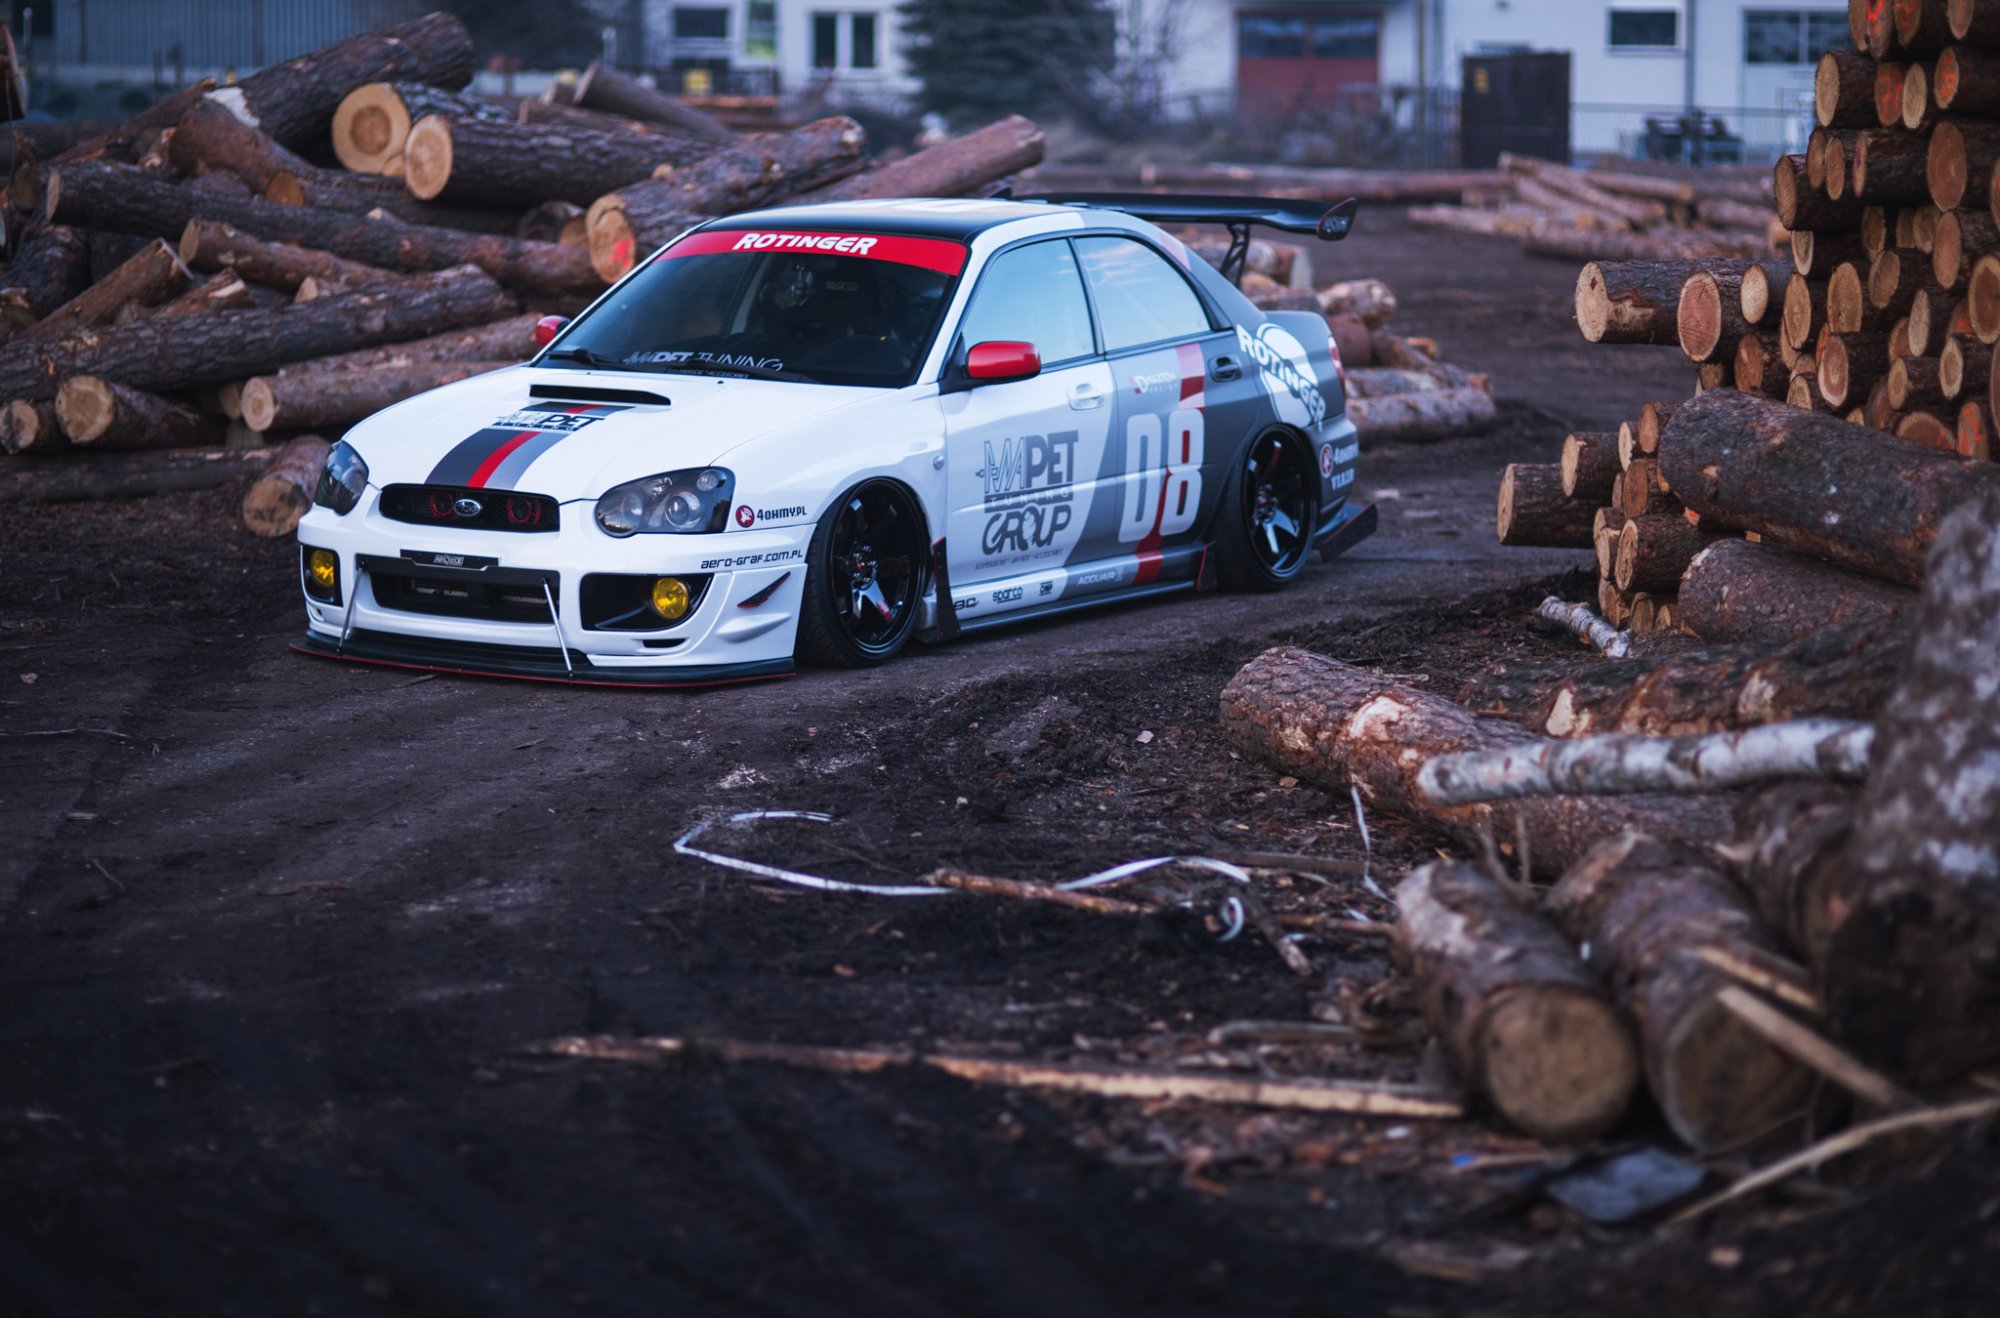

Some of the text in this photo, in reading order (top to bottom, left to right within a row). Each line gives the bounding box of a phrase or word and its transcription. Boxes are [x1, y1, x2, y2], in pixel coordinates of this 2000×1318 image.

[732, 232, 878, 255] ROTINGER
[1236, 324, 1326, 433] ROTINGER
[981, 430, 1079, 493] MAPET
[1118, 408, 1205, 543] 08
[990, 490, 1069, 507] TUNING
[982, 504, 1072, 555] GROUP
[992, 586, 1023, 604] sparco
